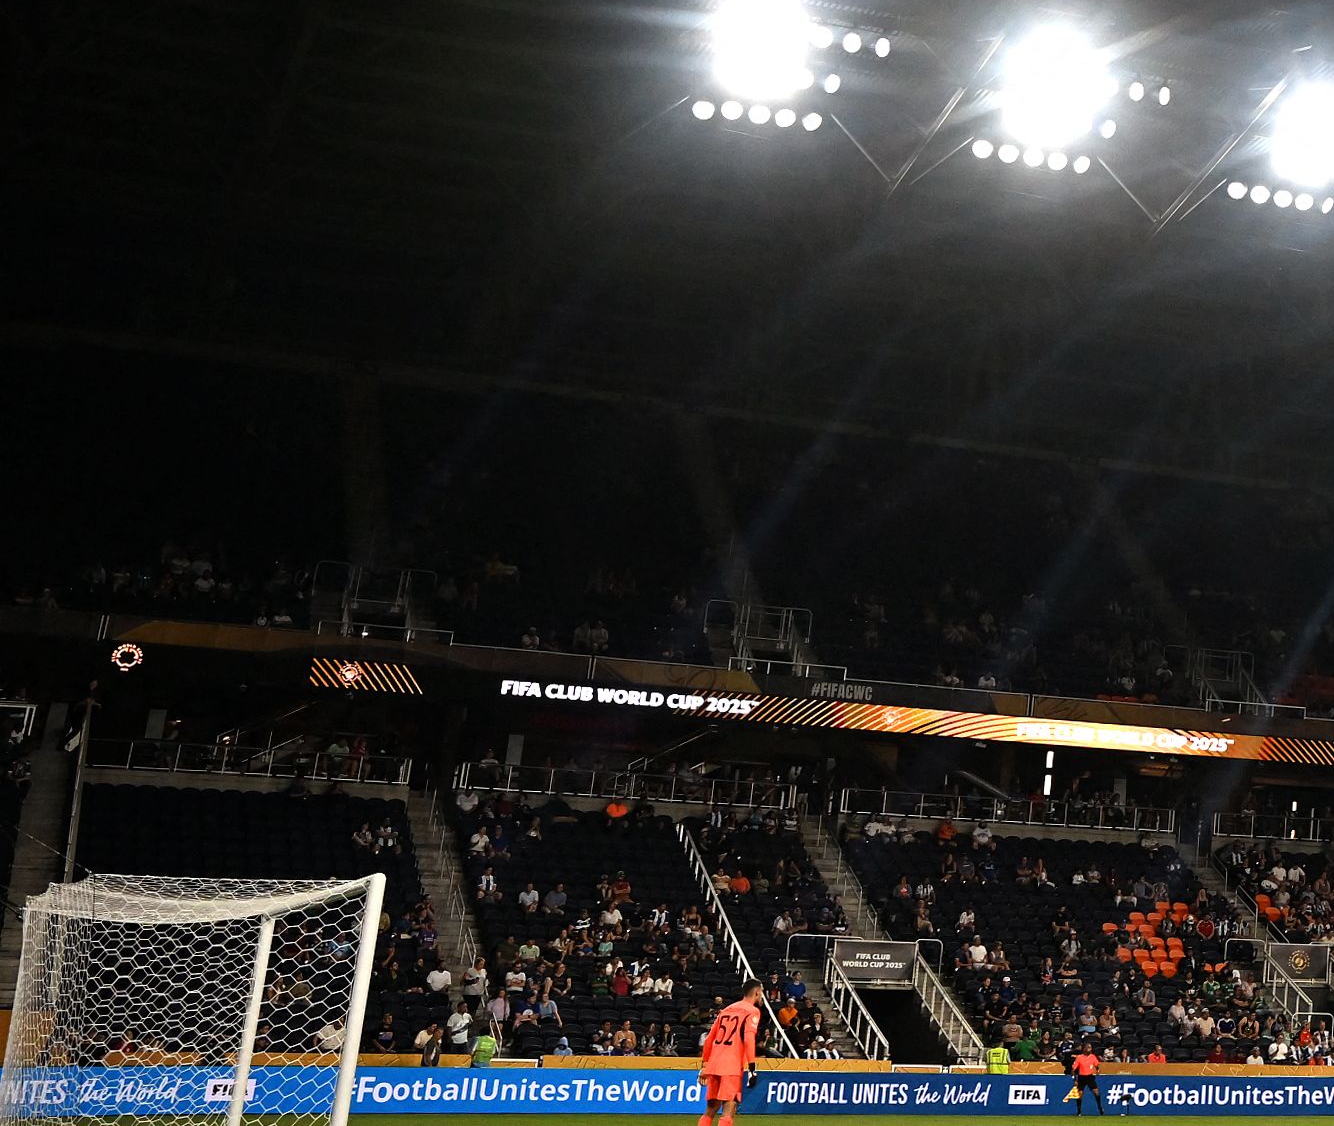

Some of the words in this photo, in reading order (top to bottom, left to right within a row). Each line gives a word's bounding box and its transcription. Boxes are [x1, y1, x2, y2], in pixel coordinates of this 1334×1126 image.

[501, 680, 541, 697] FIFA
[545, 683, 593, 701] CLUB
[597, 687, 664, 708] WORLD
[667, 694, 704, 710] CUP
[811, 682, 873, 701] #FIFACWC
[715, 1015, 739, 1045] 52
[766, 1081, 848, 1105] FOOTBALL
[851, 1083, 908, 1105] UNITES
[913, 1082, 941, 1105] the
[941, 1082, 991, 1107] World
[1014, 1089, 1041, 1101] FIFA
